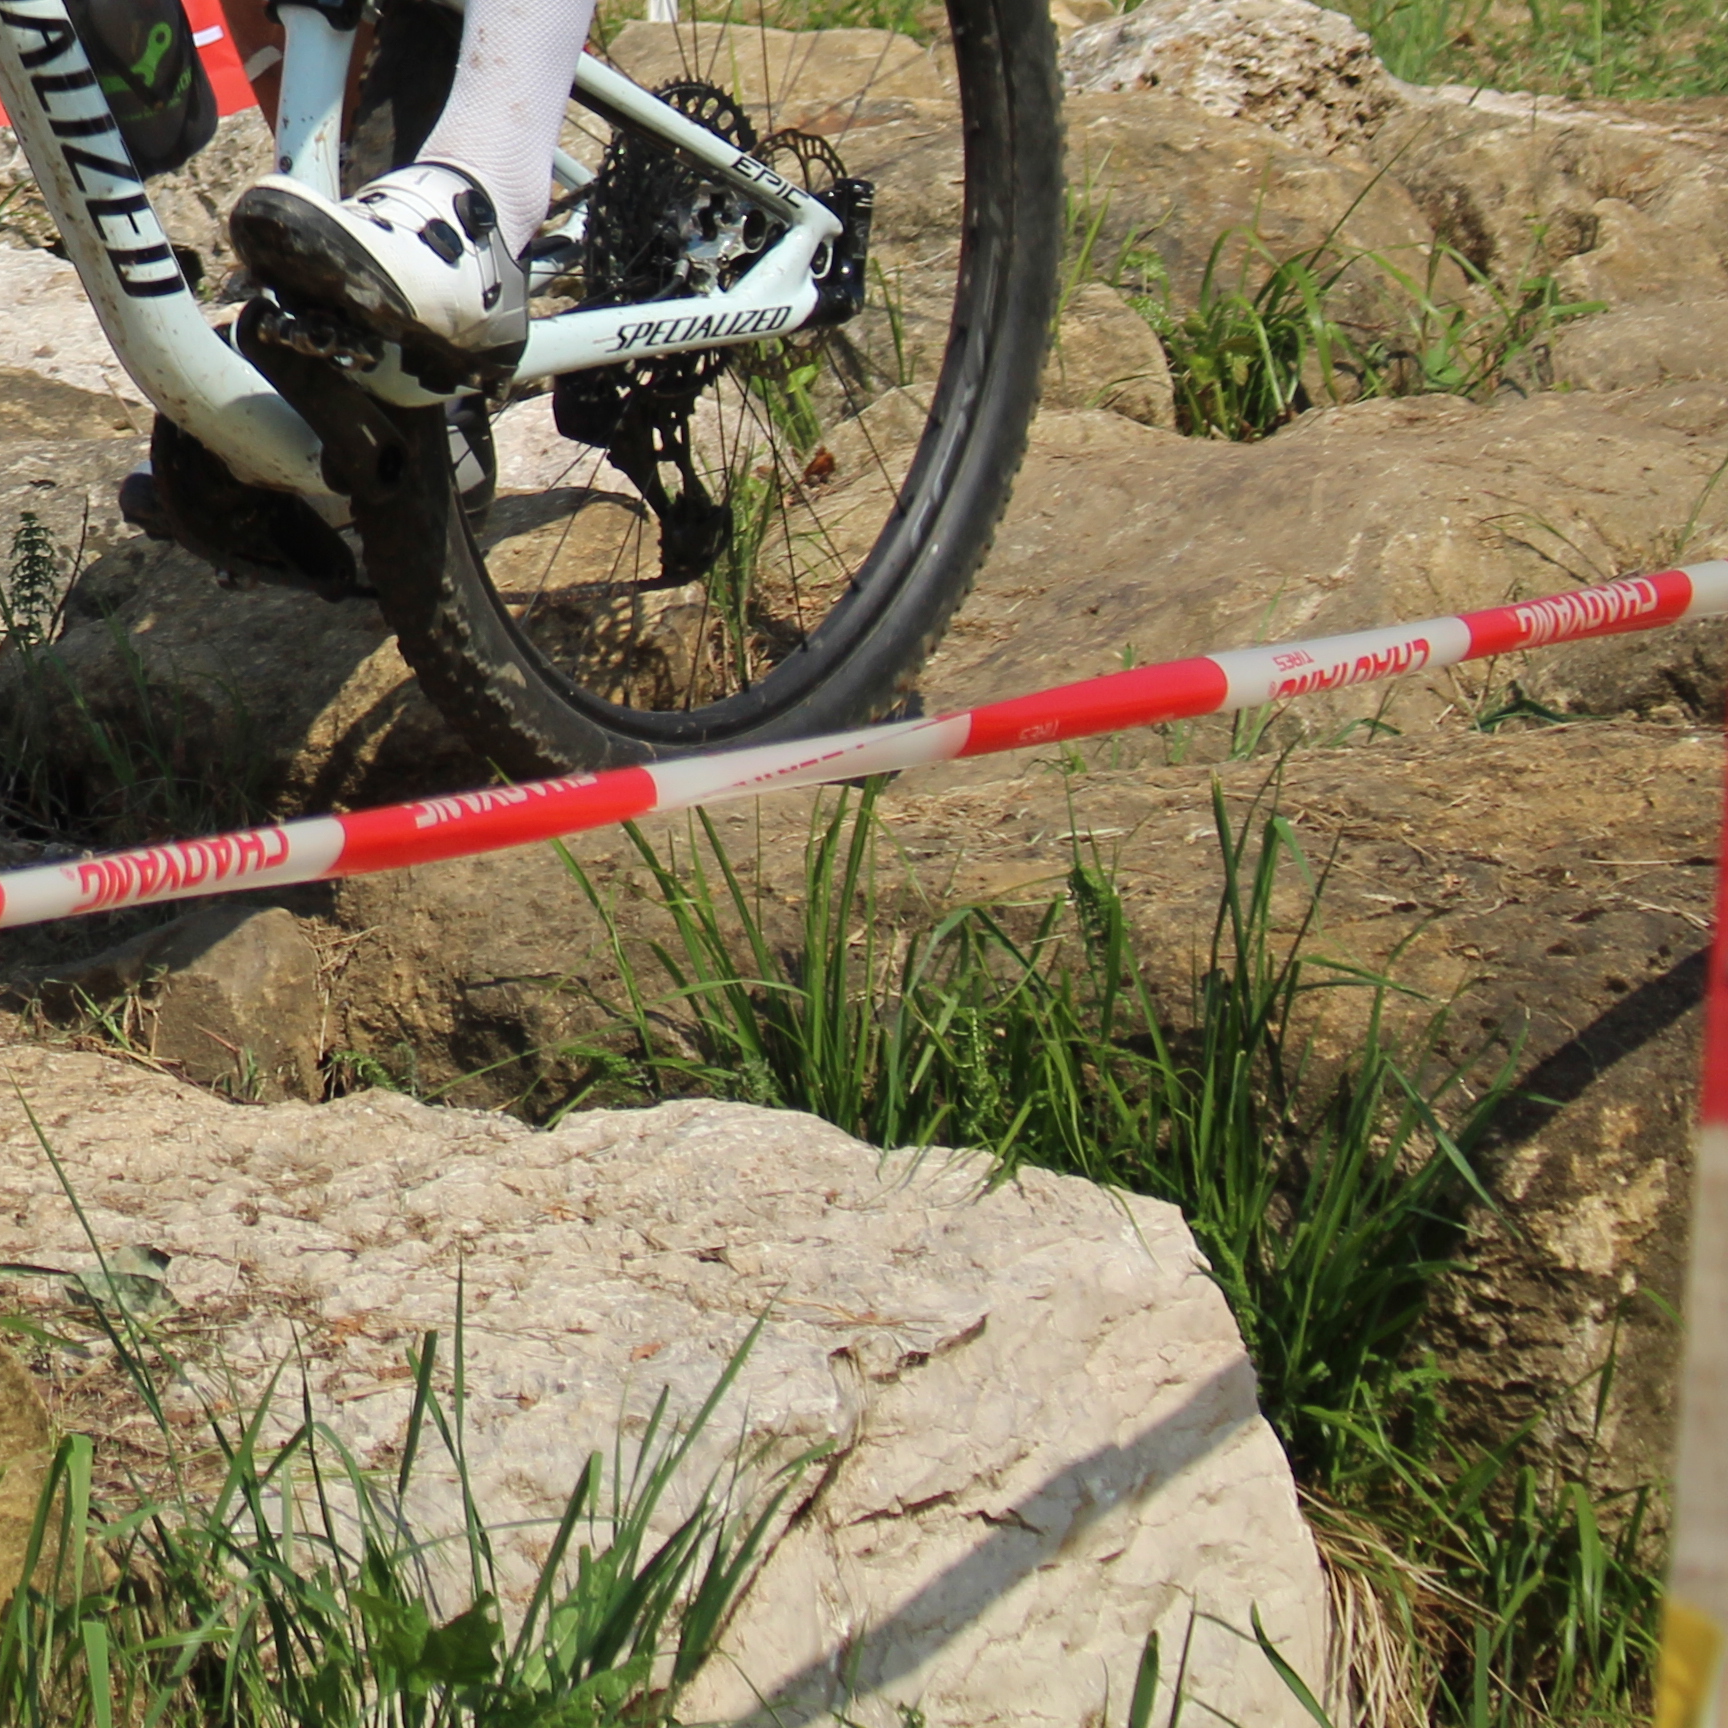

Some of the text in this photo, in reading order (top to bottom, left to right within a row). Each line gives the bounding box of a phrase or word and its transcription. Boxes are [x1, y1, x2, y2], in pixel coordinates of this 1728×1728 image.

[730, 155, 814, 208] EPIC
[610, 305, 793, 354] SPECIALIZED
[1518, 577, 1659, 646] CHAOYANG
[72, 827, 291, 914] CHAOYANG
